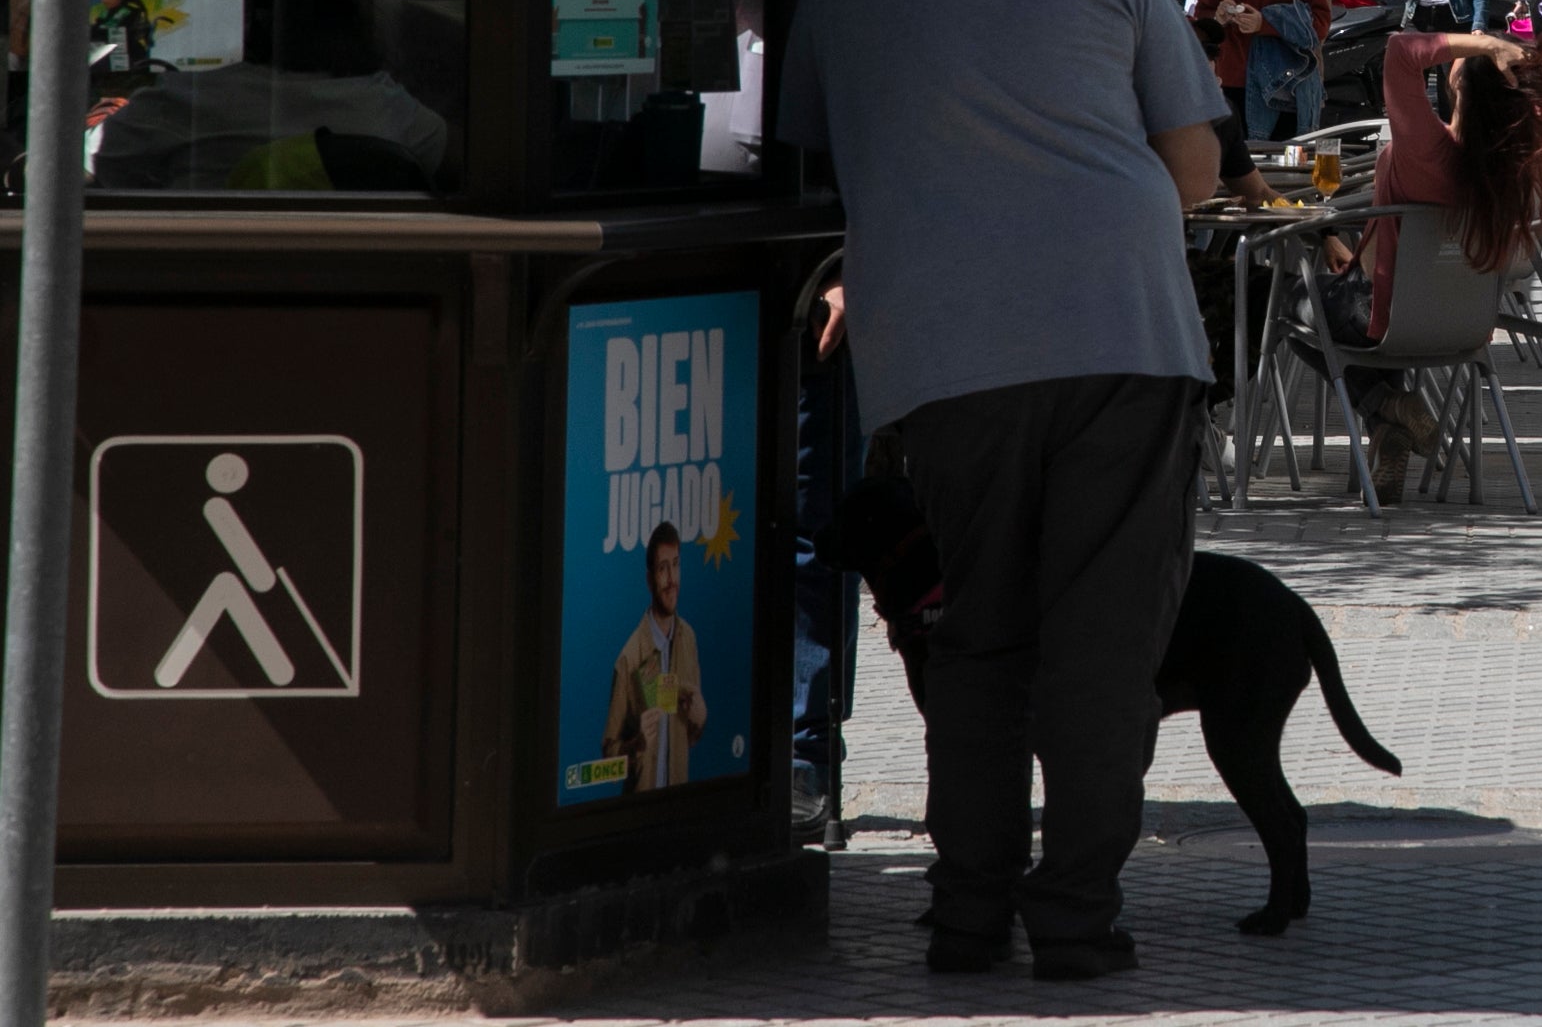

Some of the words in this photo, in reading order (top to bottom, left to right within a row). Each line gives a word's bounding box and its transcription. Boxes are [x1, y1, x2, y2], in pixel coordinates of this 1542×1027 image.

[605, 328, 725, 471] BIEN
[603, 462, 721, 553] JUGADO
[594, 760, 625, 779] ONCE
